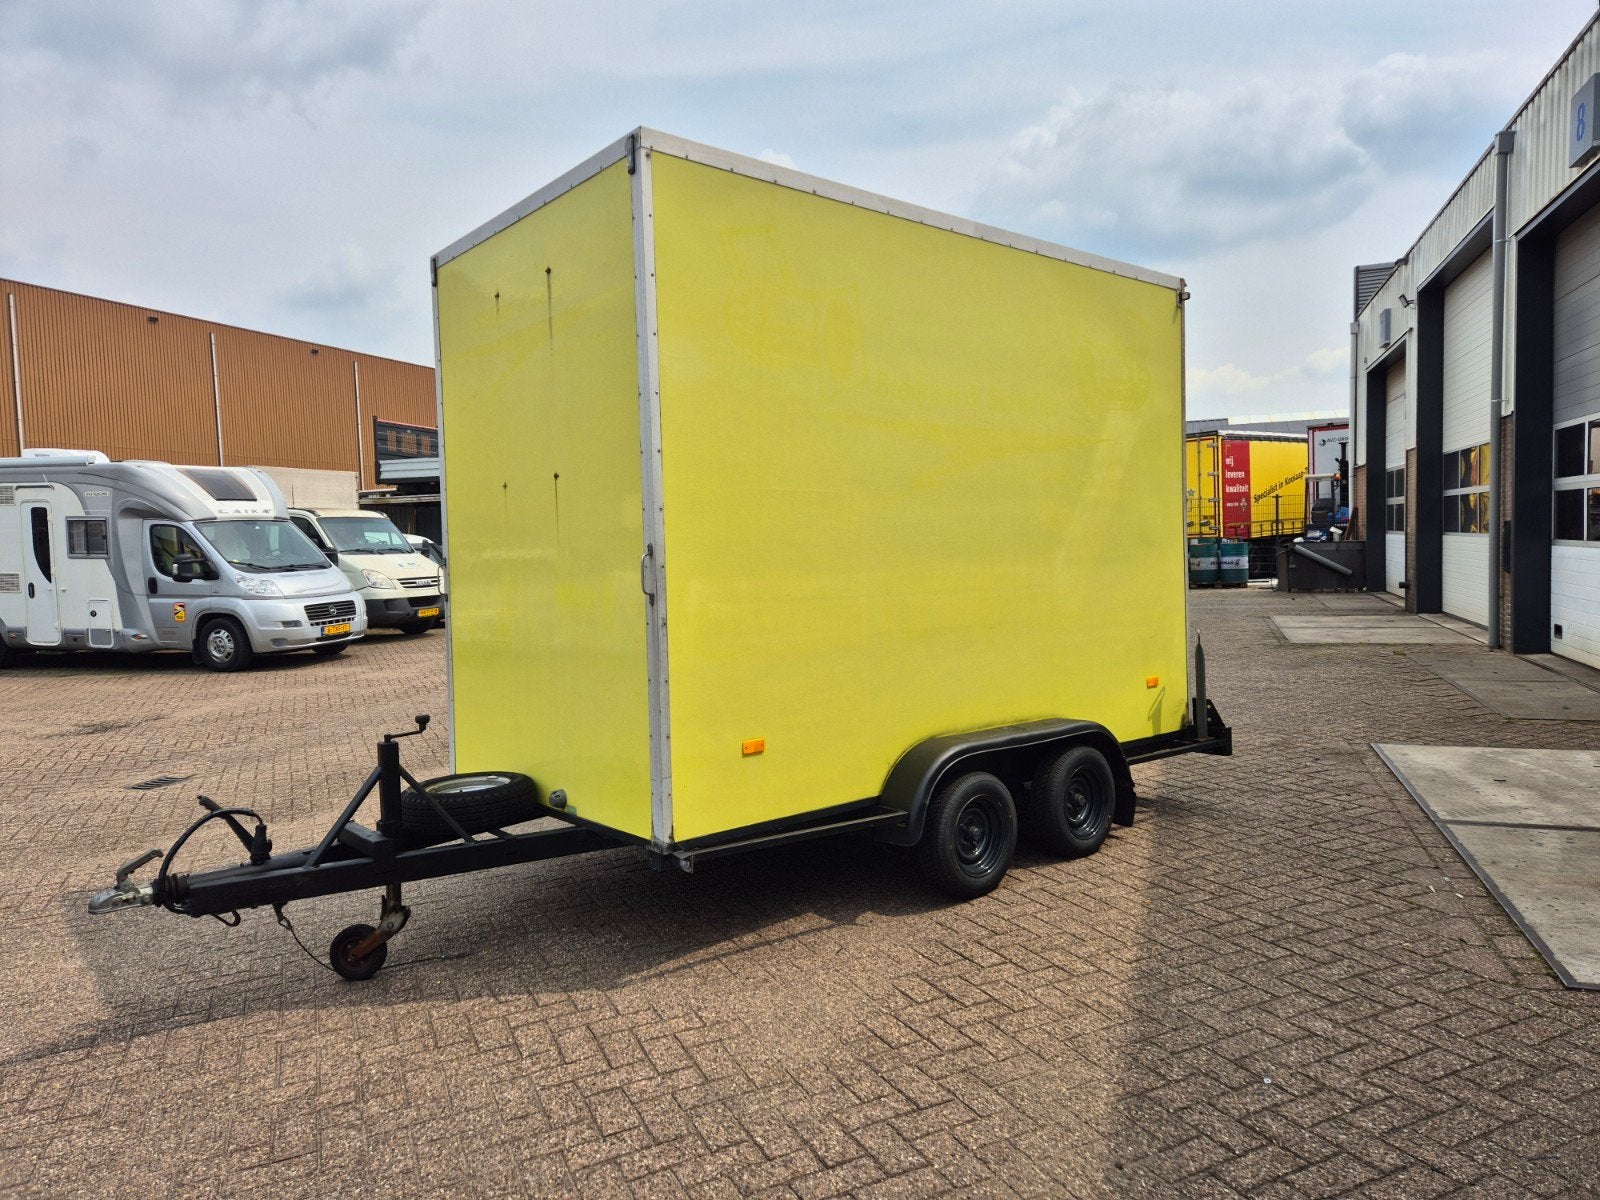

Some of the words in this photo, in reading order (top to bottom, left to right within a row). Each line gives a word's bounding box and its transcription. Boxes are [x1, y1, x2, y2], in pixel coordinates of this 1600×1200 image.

[1577, 102, 1585, 142] 8
[1225, 469, 1245, 479] leveren
[1225, 484, 1249, 493] kwaliteit
[1253, 482, 1278, 504] Specialist
[1278, 480, 1284, 490] in
